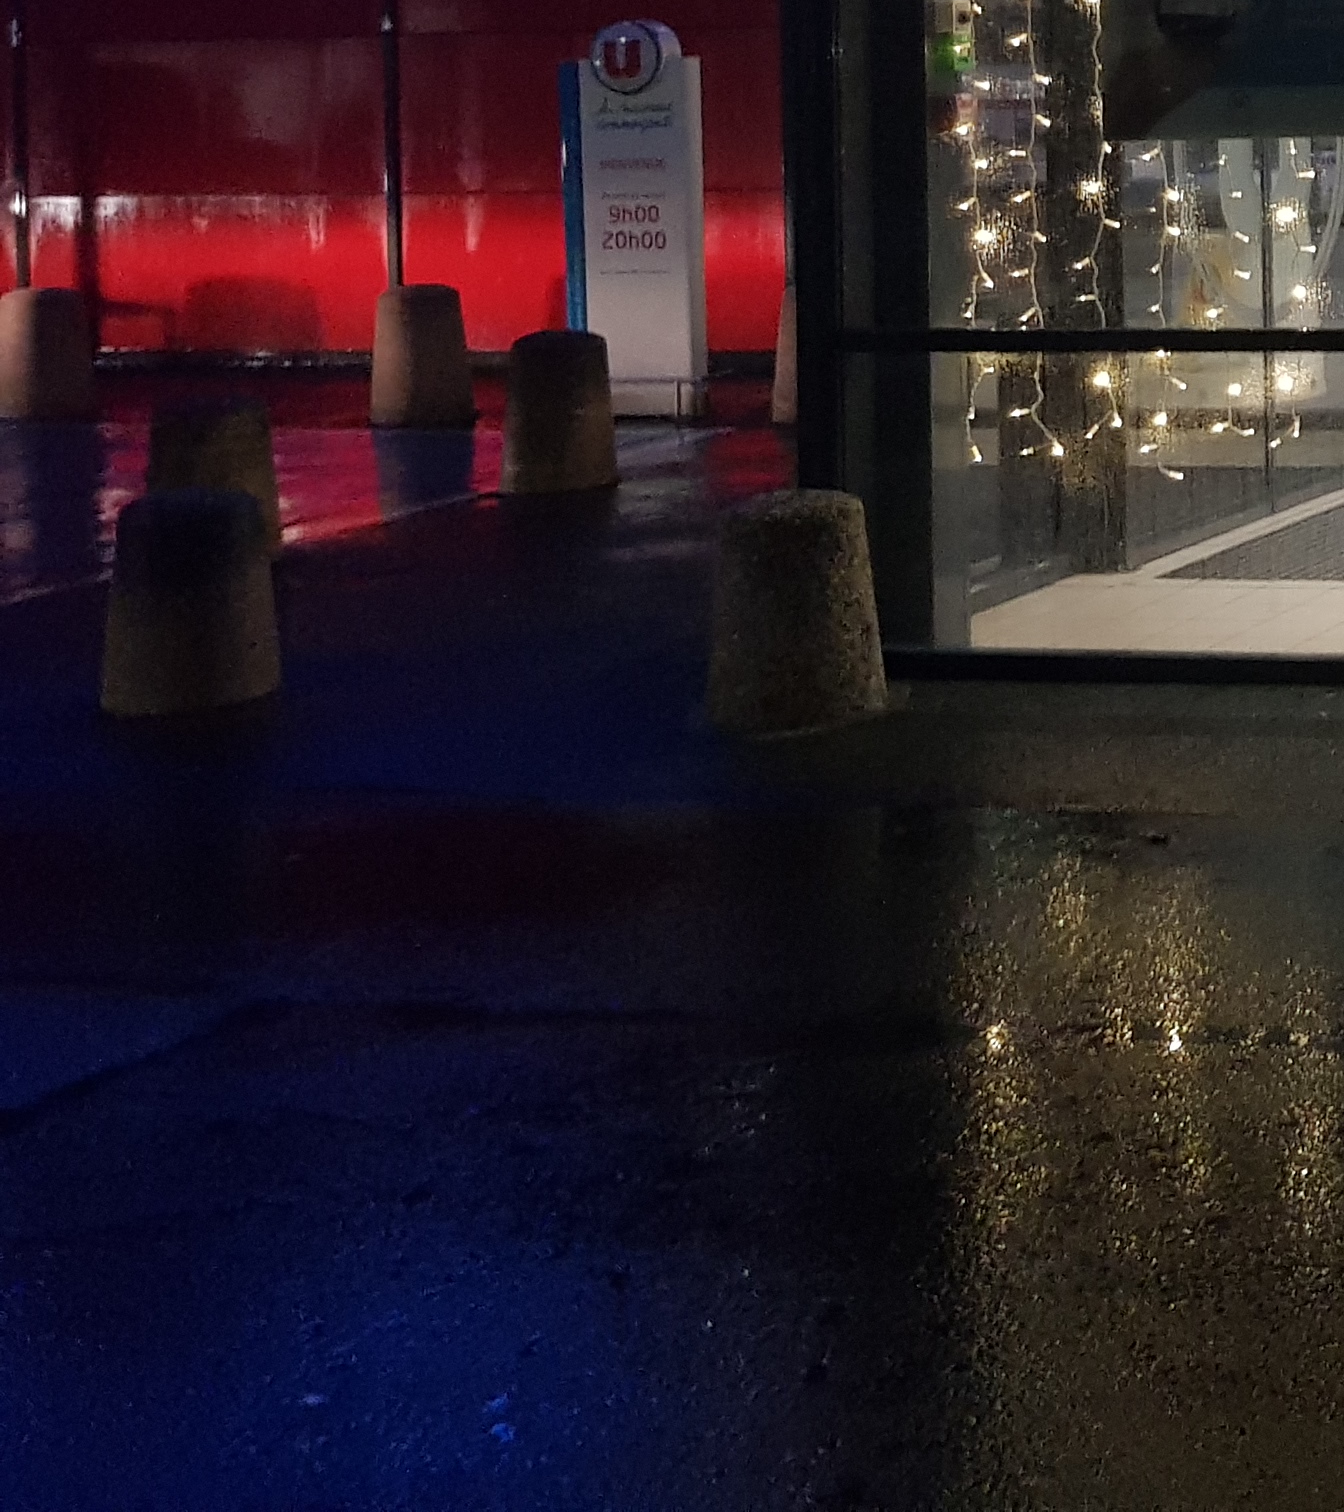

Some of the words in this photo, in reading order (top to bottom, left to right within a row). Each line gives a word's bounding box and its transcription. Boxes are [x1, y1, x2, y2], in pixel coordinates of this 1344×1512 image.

[603, 39, 642, 79] U
[609, 204, 660, 224] 9h00
[602, 230, 667, 250] 20h00
